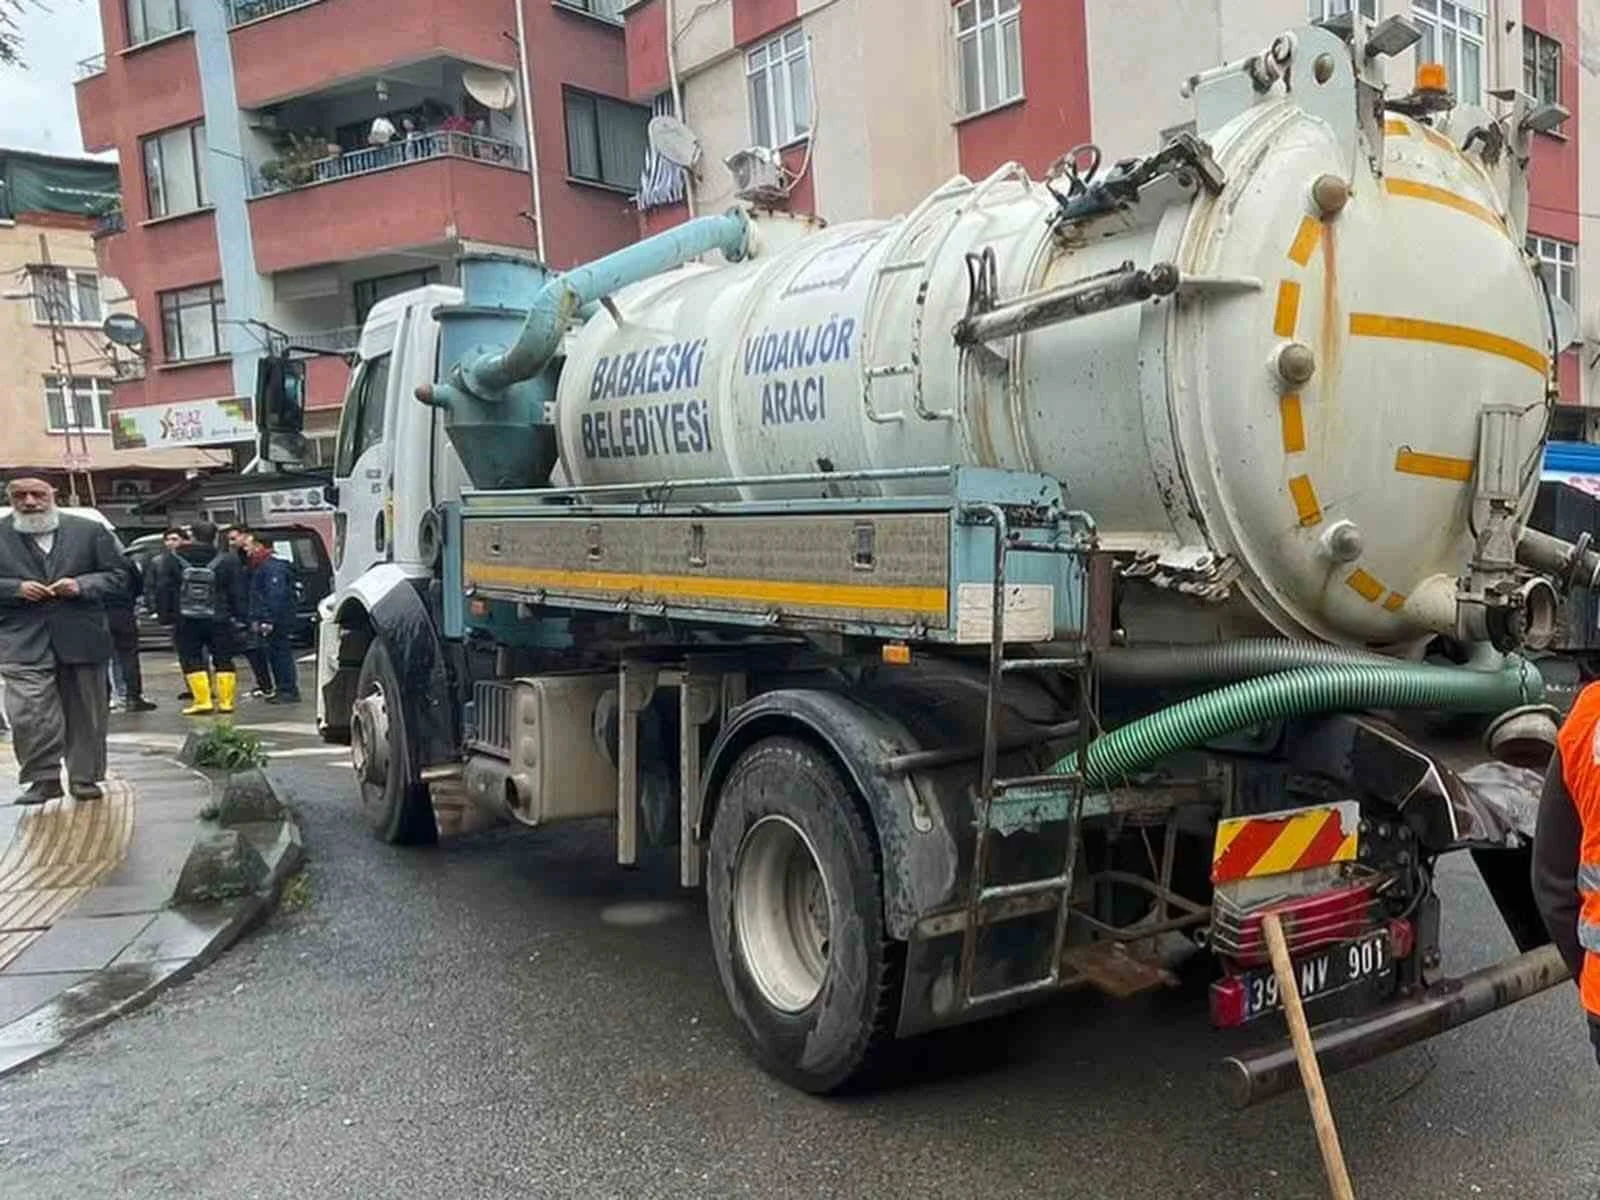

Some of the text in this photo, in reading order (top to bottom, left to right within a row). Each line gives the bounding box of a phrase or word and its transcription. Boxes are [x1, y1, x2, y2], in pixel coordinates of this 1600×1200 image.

[590, 337, 707, 400] BABAESKİ
[744, 312, 856, 376] VİDANJÖR
[581, 400, 712, 459] BELEDİYESİ
[761, 375, 826, 425] ARACI
[1251, 974, 1278, 1011] 39
[1349, 939, 1384, 979] 901
